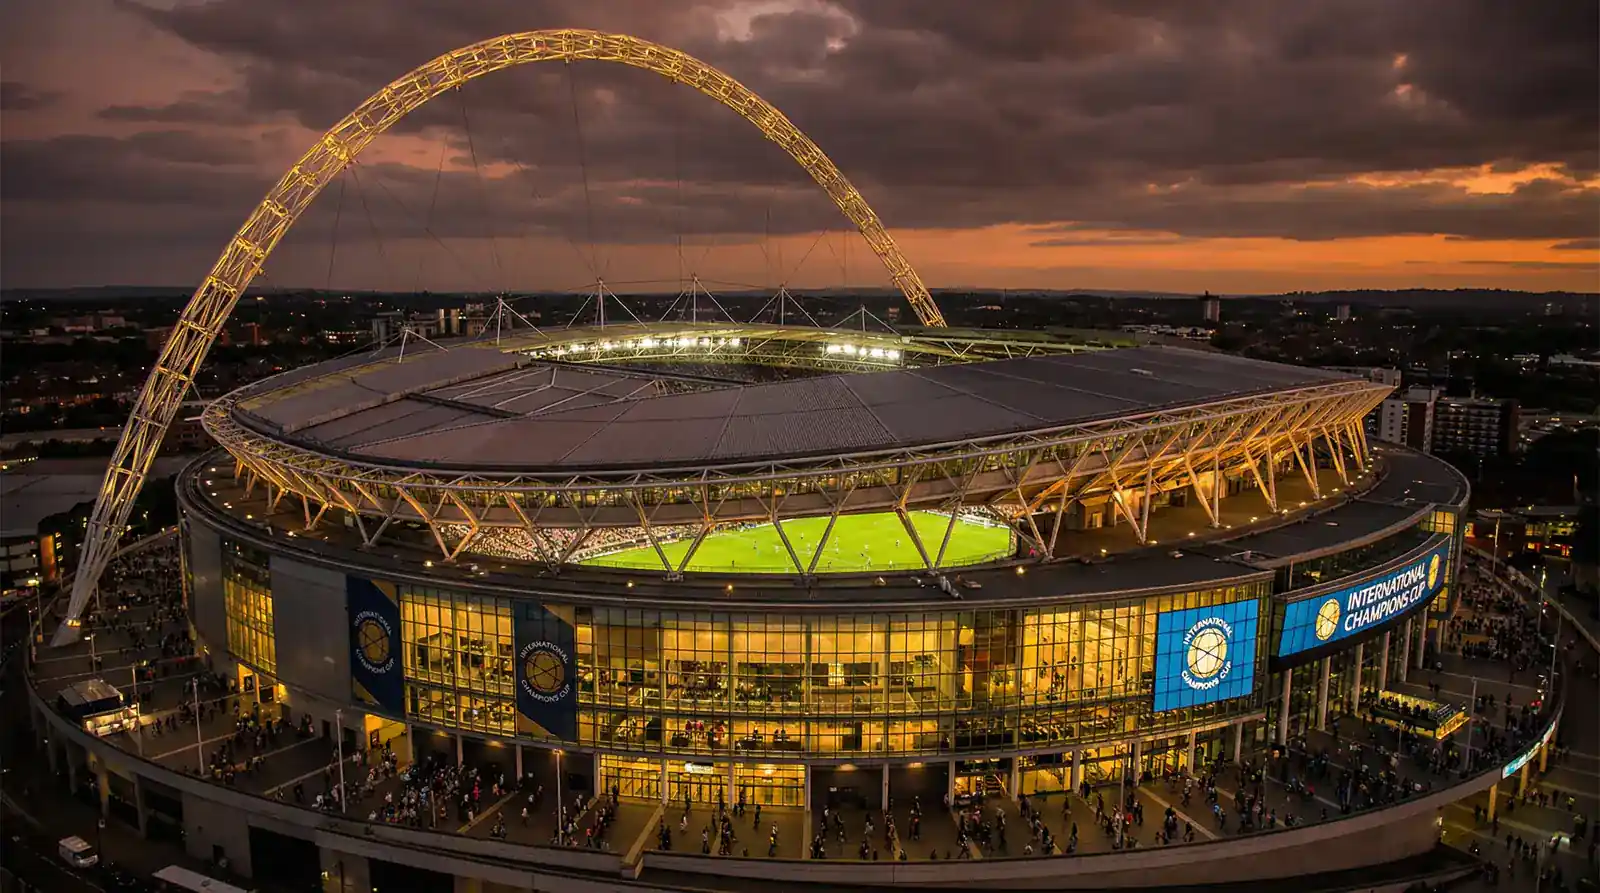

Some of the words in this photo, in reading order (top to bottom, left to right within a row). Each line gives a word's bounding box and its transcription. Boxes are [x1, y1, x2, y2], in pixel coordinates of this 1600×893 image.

[1347, 562, 1426, 611] INTERNATIONAL
[1344, 590, 1410, 632] CHAMPIONS
[1409, 580, 1426, 603] CUP
[353, 610, 393, 637] INTERNATIONAL
[1183, 617, 1233, 645] INTERNATIONAL
[385, 658, 395, 672] CUP
[520, 640, 569, 664] INTERNATIONAL
[1181, 669, 1220, 690] CHAMPIONS
[1219, 660, 1232, 679] CUP
[521, 679, 560, 703] CHAMPIONS
[559, 683, 571, 698] CUP
